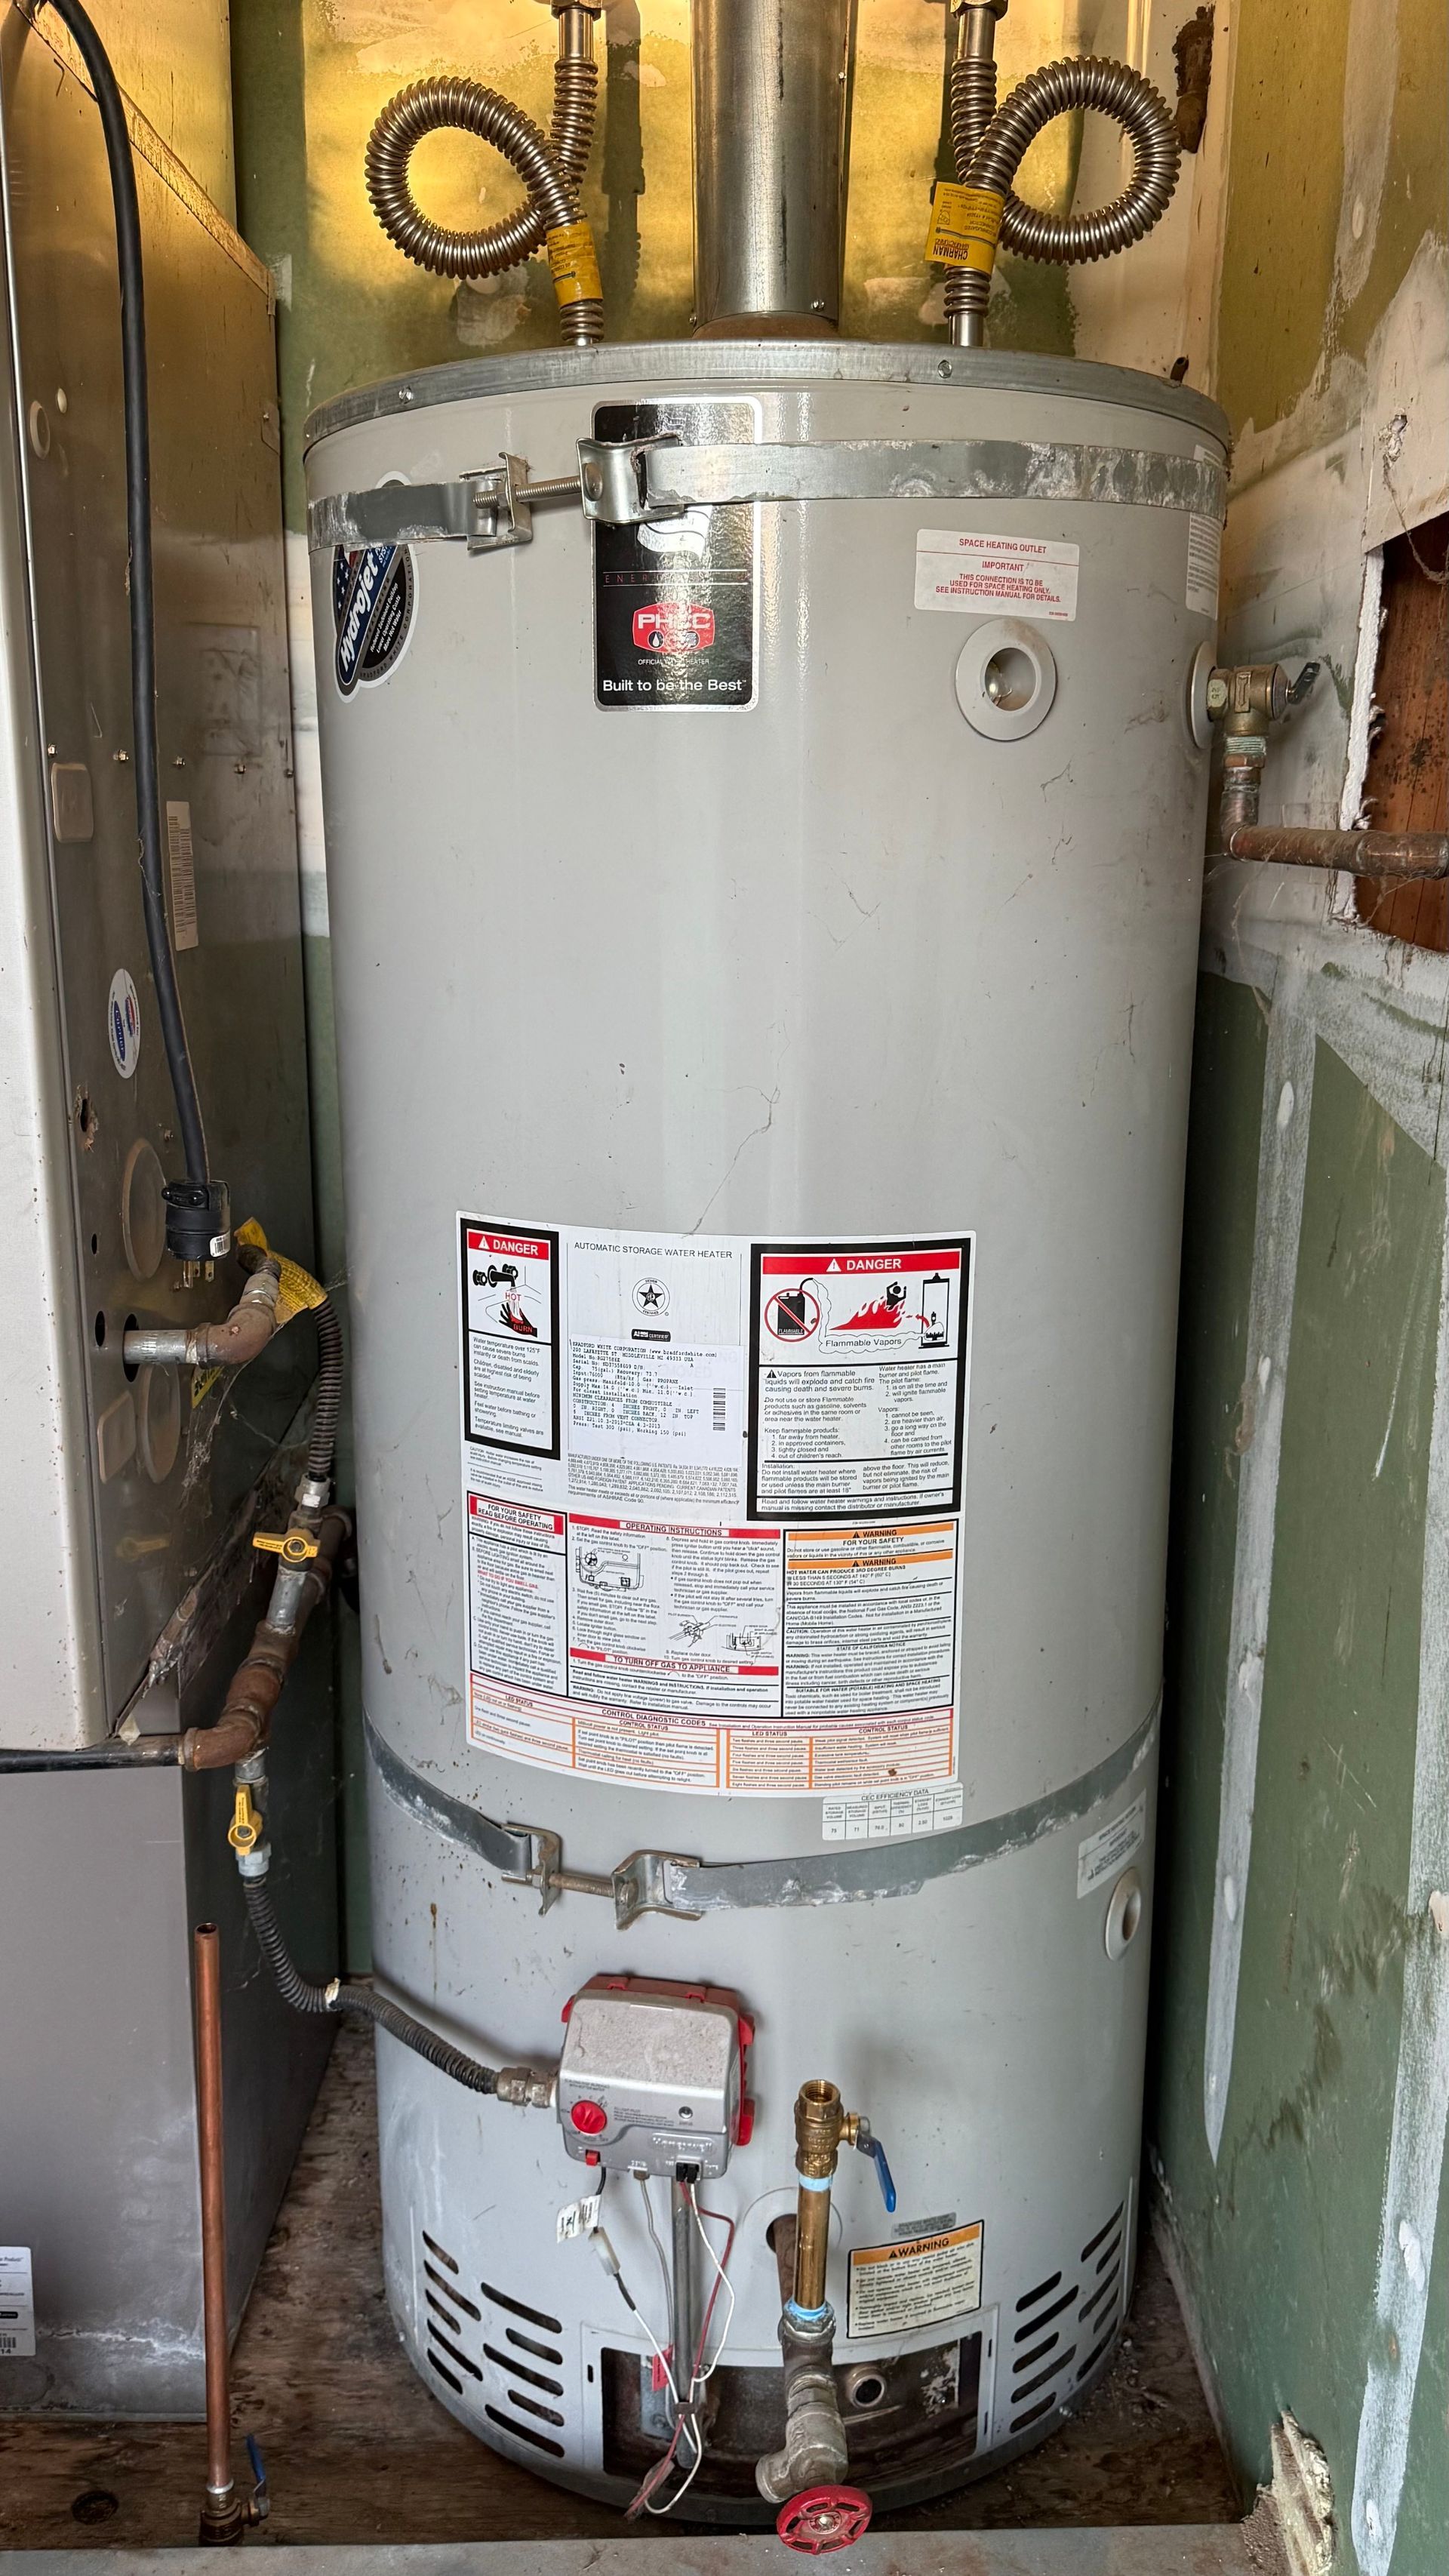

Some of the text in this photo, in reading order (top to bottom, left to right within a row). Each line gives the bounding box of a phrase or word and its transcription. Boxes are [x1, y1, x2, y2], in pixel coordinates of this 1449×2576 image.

[933, 245, 968, 260] CHARMAN
[959, 539, 1047, 554] SPACE HEATING OUTLET
[983, 561, 1024, 571] IMPORTANT
[976, 575, 1017, 583] CONNECTION
[951, 587, 994, 596] INSTRUCTION
[995, 590, 1021, 599] MANUAL
[1036, 594, 1060, 602] DETAILS.
[1007, 584, 1032, 592] HEATING
[340, 552, 378, 672] Hydrojet
[389, 636, 404, 661] WHITE
[404, 549, 413, 629] CORPORATION
[377, 596, 401, 654] Lower Operating Costs
[392, 611, 402, 626] Water
[371, 629, 380, 652] Reduced
[378, 604, 390, 629] Sediment
[604, 679, 633, 691] Built
[637, 681, 652, 691] to
[657, 679, 675, 691] be
[680, 679, 703, 691] the
[494, 1239, 538, 1255] DANGER
[574, 1242, 620, 1253] AUTOMATIC
[623, 1246, 663, 1255] STORAGE
[665, 1248, 695, 1257] WATER
[847, 1258, 902, 1270] DANGER
[506, 1292, 521, 1301] HOT
[514, 1324, 533, 1332] BURN
[826, 1338, 902, 1347] Flammable Vapors
[478, 1508, 552, 1530] READ BEFORE OPERATING
[501, 1507, 517, 1516] YOUR
[518, 1511, 541, 1521] SAFETY
[626, 1522, 722, 1535] OPERATING INSTRUCTIONS
[625, 1657, 643, 1666] TURN
[689, 1663, 730, 1673] APPLIANCE
[602, 1709, 706, 1726] CONTROL DIAGNOSTIC CODES
[898, 2238, 949, 2257] WARNING
